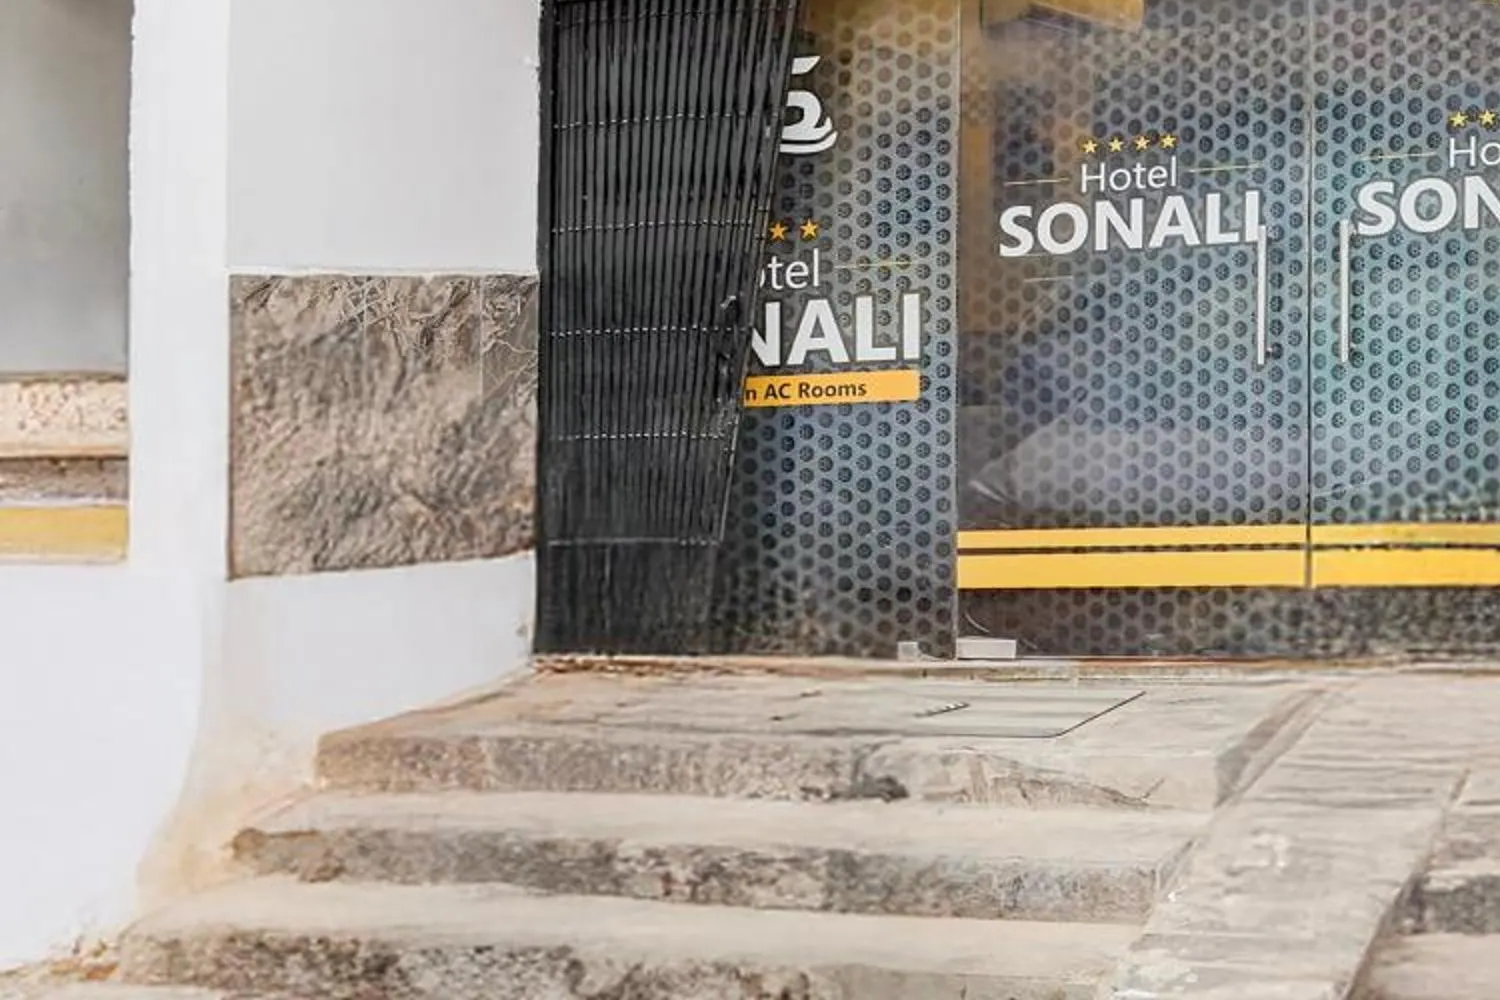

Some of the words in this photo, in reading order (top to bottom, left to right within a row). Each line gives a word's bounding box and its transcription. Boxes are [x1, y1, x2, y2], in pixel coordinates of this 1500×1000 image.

[1081, 155, 1177, 193] Hotel
[1000, 190, 1260, 257] SONALI
[751, 293, 921, 367] NALI
[764, 382, 792, 400] AC
[799, 382, 868, 399] Rooms
